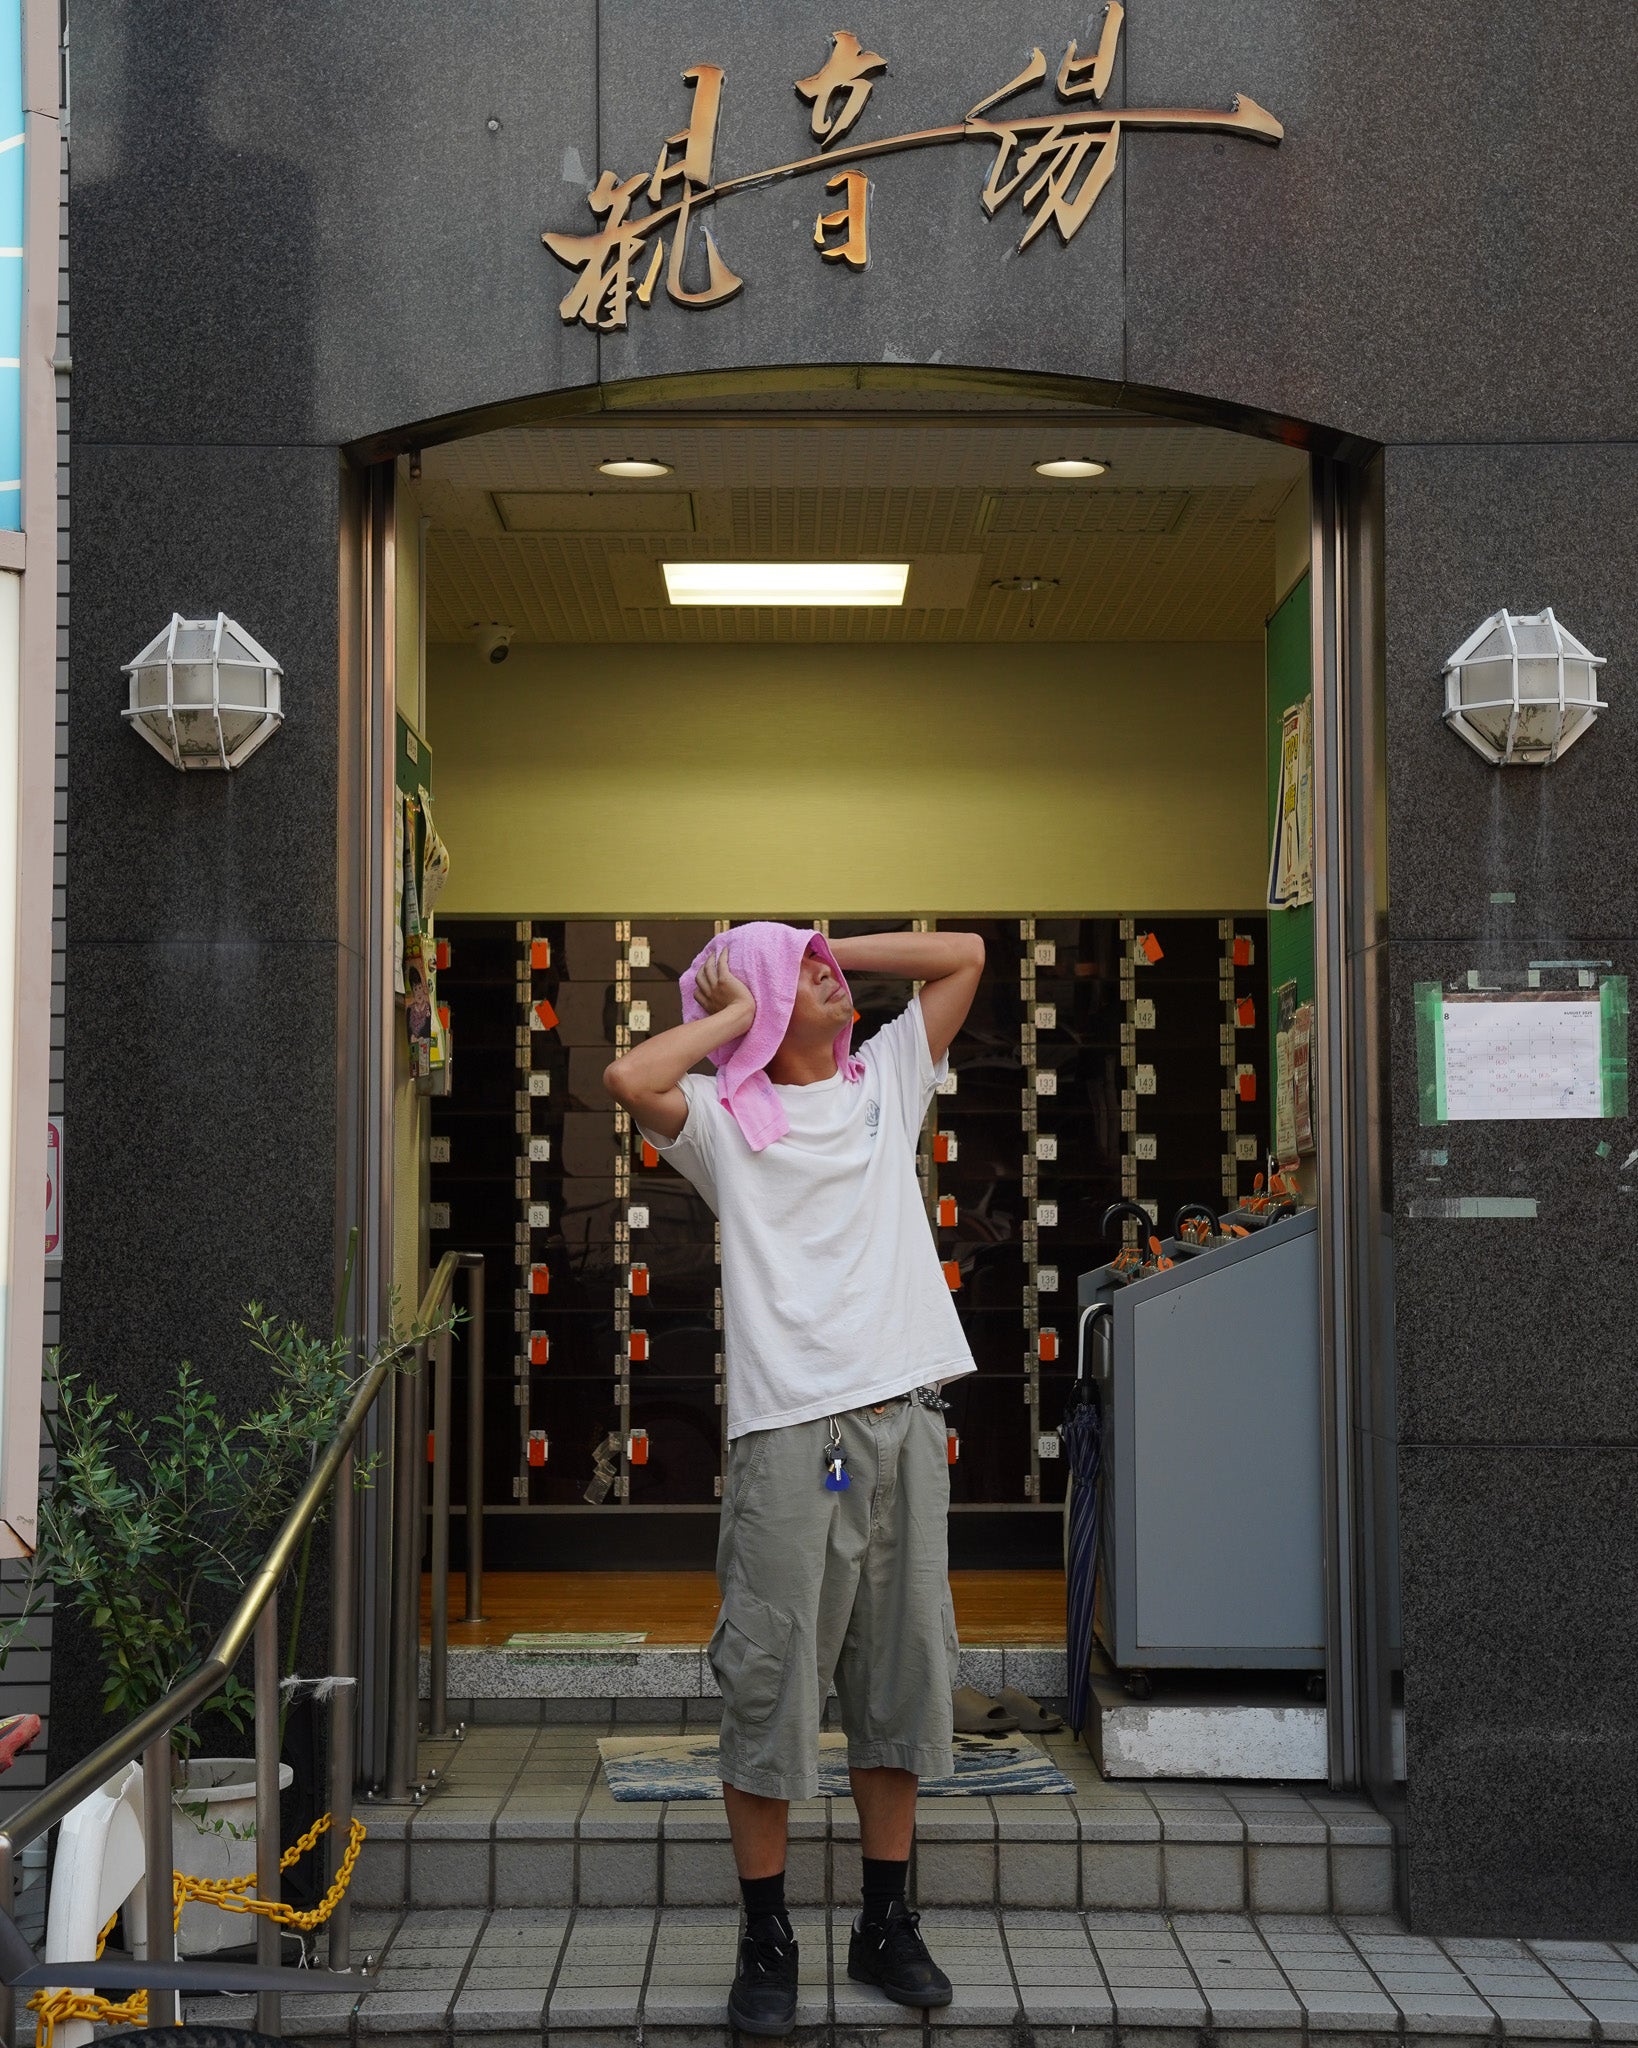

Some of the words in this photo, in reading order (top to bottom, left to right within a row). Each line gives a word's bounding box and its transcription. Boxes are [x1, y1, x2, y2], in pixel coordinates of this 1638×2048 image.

[1038, 950, 1051, 958] 131
[634, 1014, 644, 1022] 92
[1039, 1013, 1052, 1022] 132
[1138, 1012, 1152, 1021] 142
[534, 1080, 544, 1088] 83
[1039, 1078, 1054, 1087] 133
[1139, 1078, 1153, 1086] 143
[534, 1146, 544, 1154] 84
[1039, 1144, 1054, 1152] 134
[1139, 1144, 1153, 1152] 144
[1240, 1144, 1253, 1152] 154
[534, 1212, 544, 1220] 85
[633, 1212, 643, 1220] 95
[1040, 1210, 1055, 1218] 135
[1040, 1275, 1055, 1284] 136
[1041, 1441, 1056, 1450] 138
